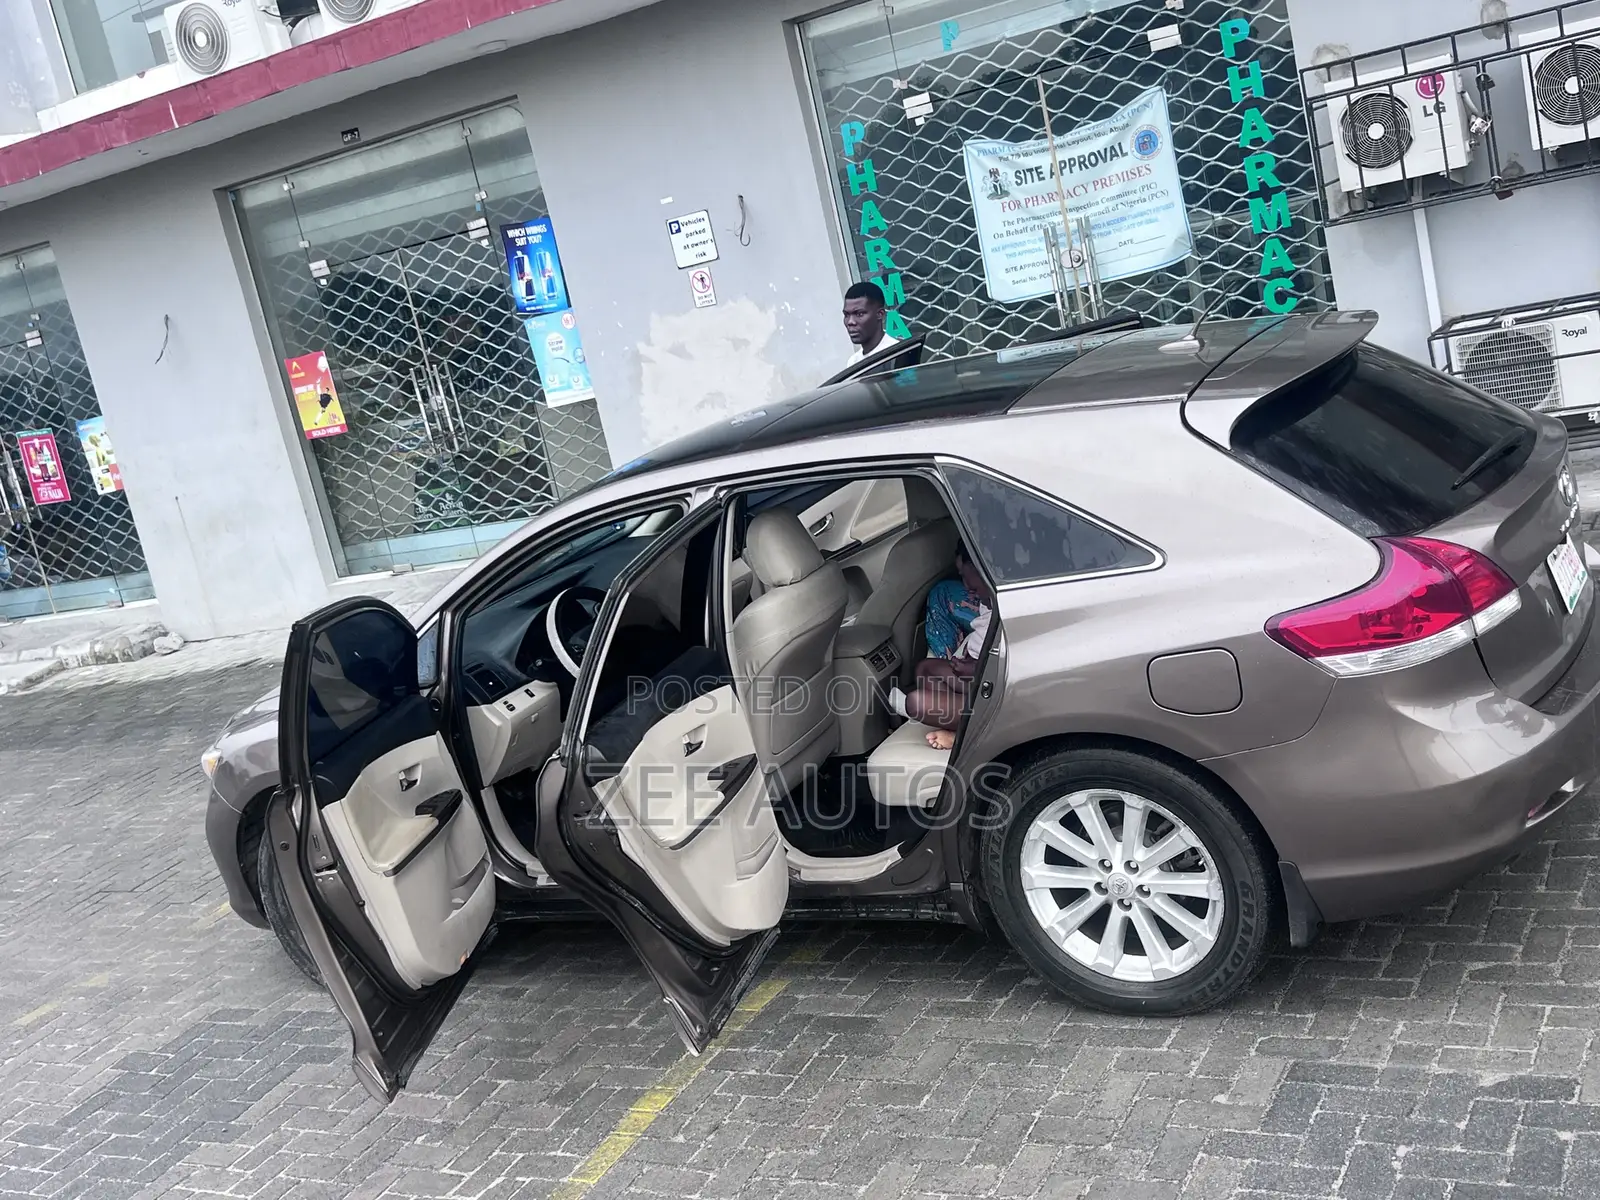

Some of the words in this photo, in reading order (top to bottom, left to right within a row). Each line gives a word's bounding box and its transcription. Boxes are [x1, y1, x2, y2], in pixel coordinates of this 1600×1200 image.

[939, 19, 960, 52] P
[1422, 101, 1446, 118] LG
[1014, 165, 1046, 187] SITE
[1049, 142, 1129, 179] APPROVAL
[1219, 18, 1297, 314] PHARMAC
[1001, 199, 1023, 213] FOR
[1092, 163, 1152, 192] PREMISES
[993, 232, 1004, 240] On
[1005, 226, 1028, 237] Behalf
[1029, 224, 1037, 232] of
[1111, 203, 1120, 212] of
[1120, 196, 1147, 209] Nigeria
[1147, 188, 1169, 202] (PCN)
[1002, 220, 1015, 228] The
[1016, 209, 1064, 224] Pharmaceutica
[1066, 201, 1100, 214] Inspection
[1100, 187, 1138, 204] Committee
[1138, 181, 1158, 194] (PIC)
[506, 227, 526, 239] WHICH
[680, 216, 706, 228] Vehicles
[685, 227, 706, 239] parked
[840, 120, 913, 340] PHARMA
[683, 243, 690, 251] at
[695, 250, 707, 259] risk
[1004, 265, 1018, 274] SITE
[1019, 259, 1049, 271] APPROVA
[1118, 238, 1134, 248] DATE
[1012, 277, 1028, 286] Serial
[1561, 325, 1588, 338] Royal
